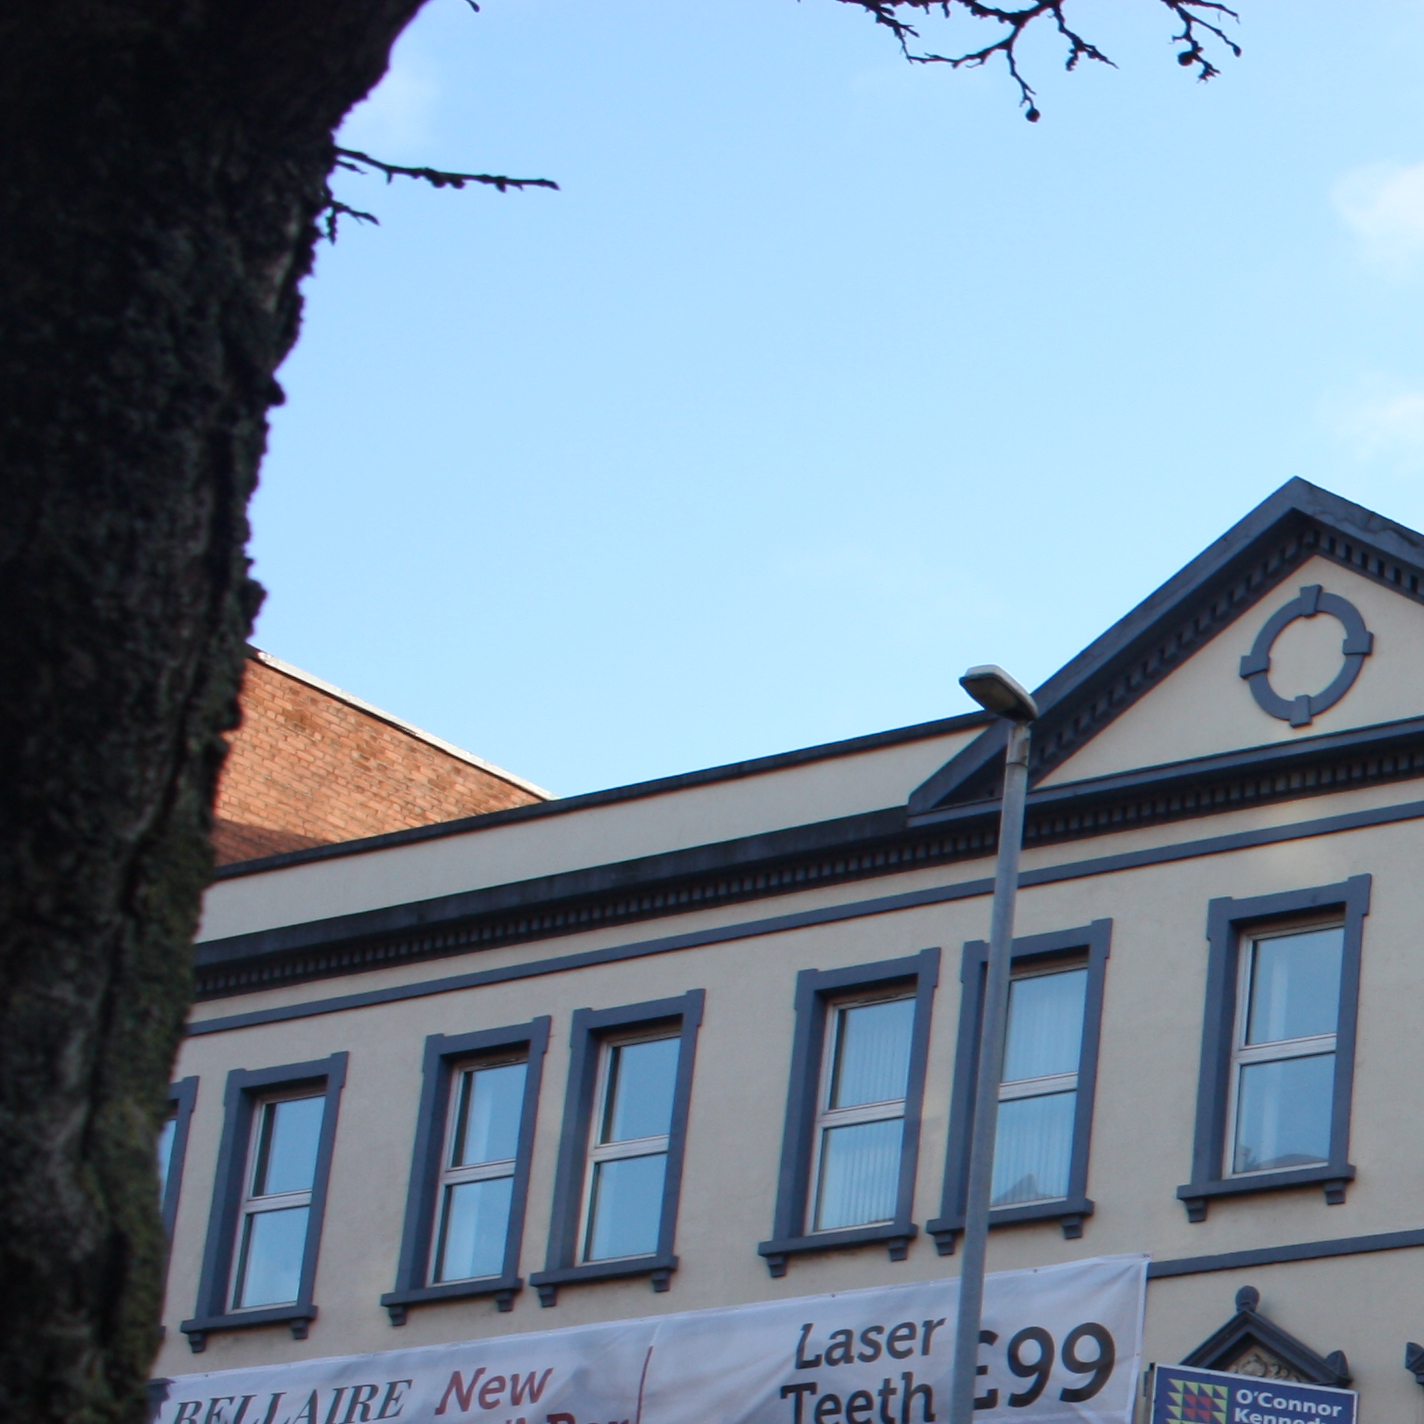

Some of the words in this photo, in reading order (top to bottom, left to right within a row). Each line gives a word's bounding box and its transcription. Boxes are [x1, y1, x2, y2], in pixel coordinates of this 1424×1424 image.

[794, 1315, 947, 1371] Laser
[434, 1366, 555, 1417] New
[1235, 1388, 1343, 1419] O'Connor
